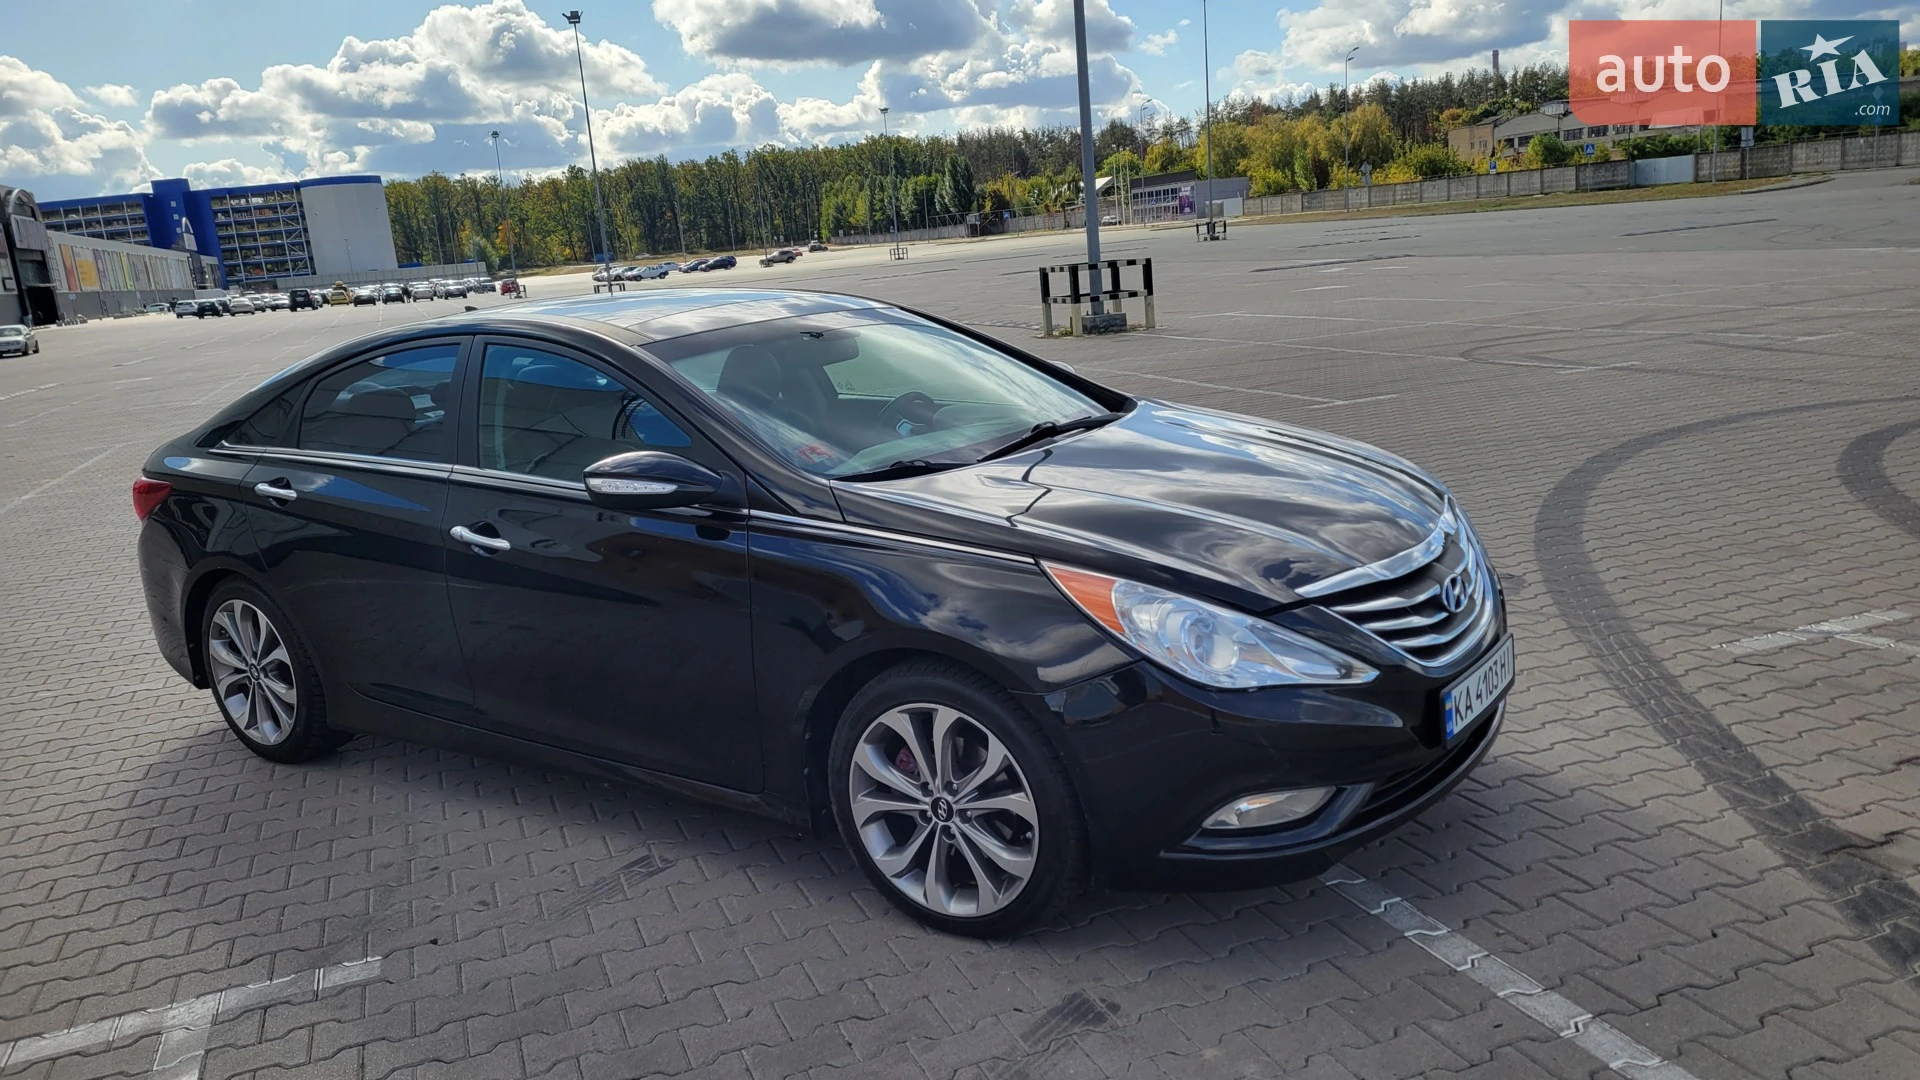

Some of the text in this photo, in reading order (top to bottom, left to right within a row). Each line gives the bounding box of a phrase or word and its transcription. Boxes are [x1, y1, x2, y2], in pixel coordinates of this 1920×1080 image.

[1454, 647, 1511, 726] KA 4103 HI
